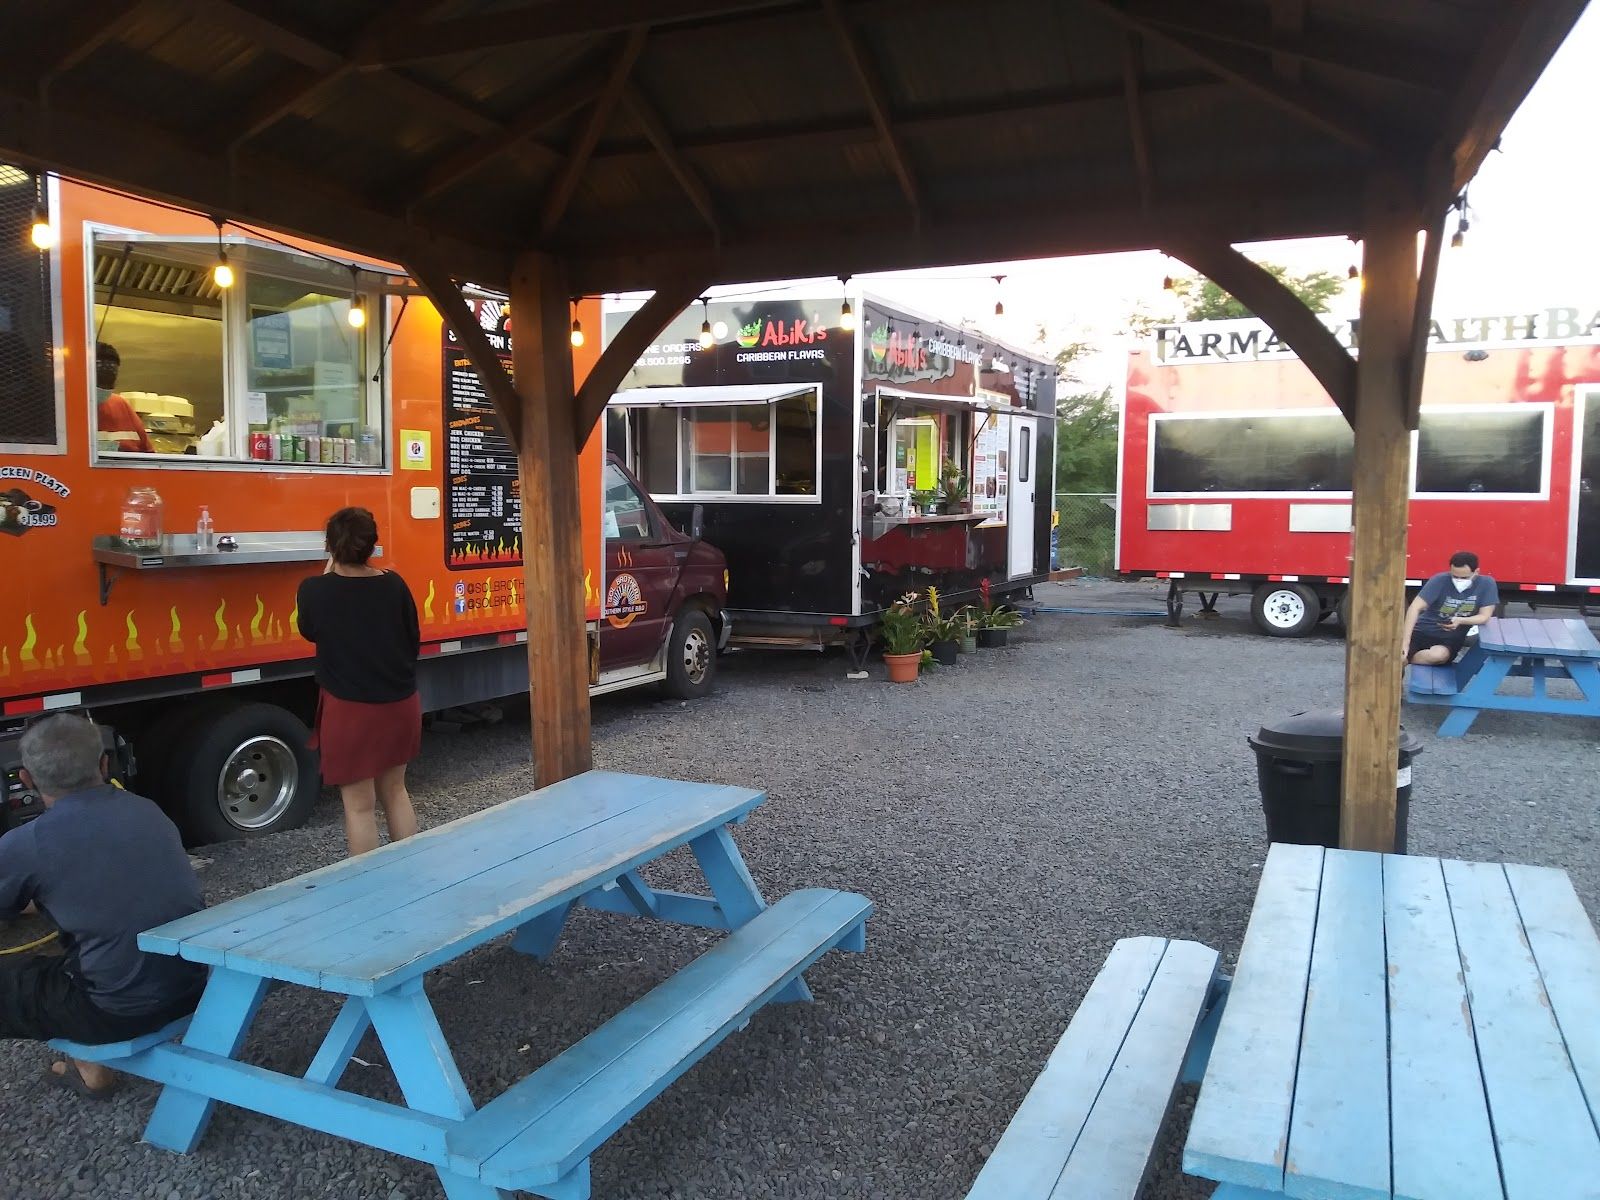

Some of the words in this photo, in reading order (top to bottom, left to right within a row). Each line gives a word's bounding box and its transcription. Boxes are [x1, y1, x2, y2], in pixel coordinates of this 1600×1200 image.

[1152, 325, 1344, 363] FARMA
[1346, 314, 1539, 349] ALTH
[737, 352, 787, 363] CARIBBEAN
[788, 349, 824, 361] FLAVAS
[0, 467, 32, 479] CKEN
[35, 472, 70, 498] PLATE
[467, 579, 525, 595] @SOLBROTH
[467, 593, 525, 609] @SOLBROTH
